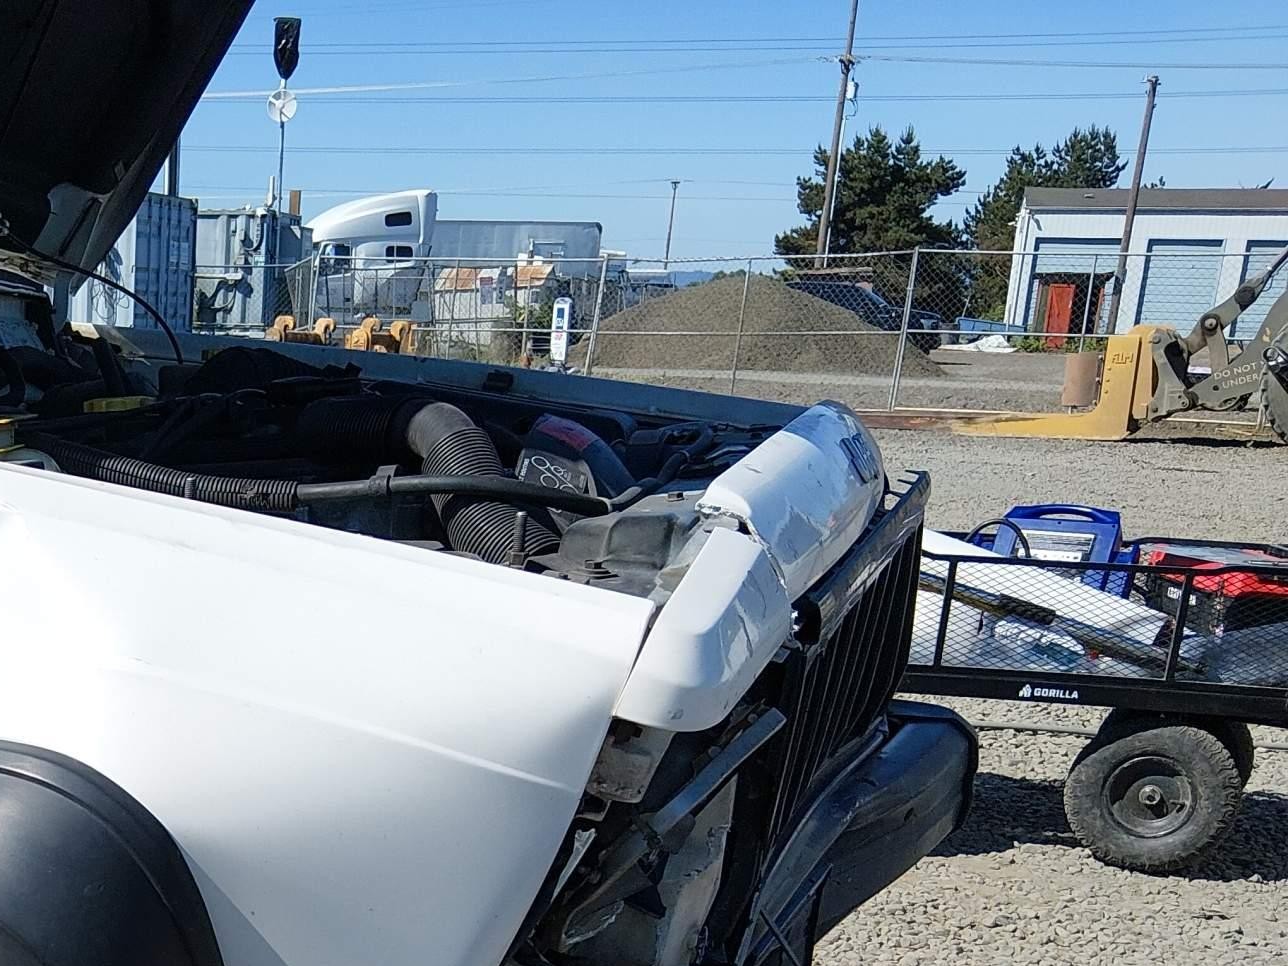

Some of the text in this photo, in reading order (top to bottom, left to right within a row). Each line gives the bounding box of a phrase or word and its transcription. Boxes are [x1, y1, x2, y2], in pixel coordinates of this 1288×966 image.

[1213, 361, 1258, 381] DO NOT
[1221, 372, 1261, 390] UNDER
[1034, 687, 1079, 699] GORILLA
